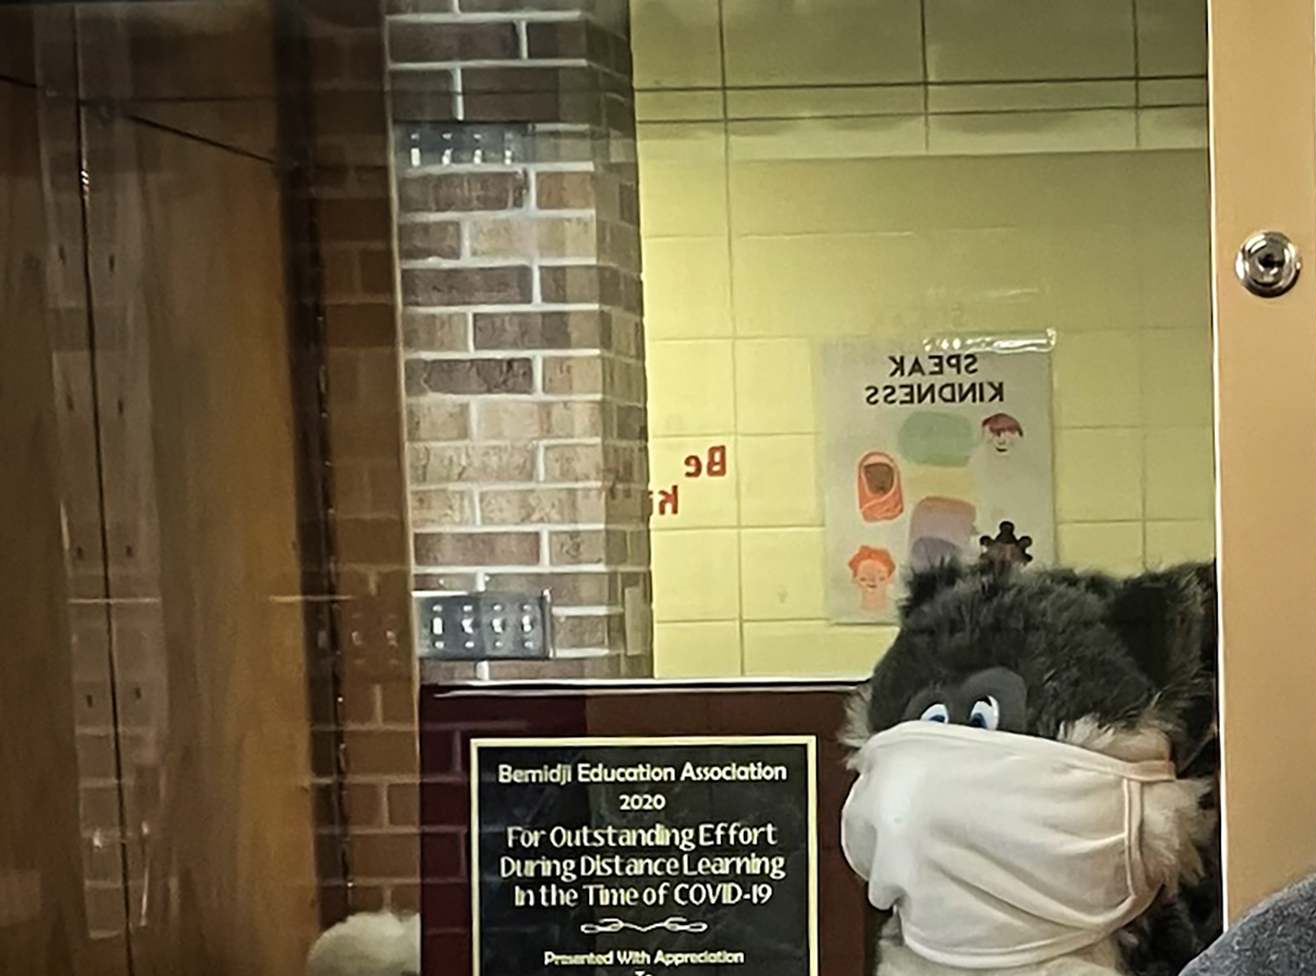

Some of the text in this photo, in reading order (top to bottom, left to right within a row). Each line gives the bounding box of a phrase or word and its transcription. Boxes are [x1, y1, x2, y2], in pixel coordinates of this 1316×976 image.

[498, 762, 788, 785] Bemidji Education Association
[619, 794, 666, 810] 2020
[507, 823, 778, 851] For Outstanding Effort
[500, 852, 786, 882] During Distance Learning
[514, 883, 773, 907] In the Time of COVID-19
[544, 950, 744, 966] Presented With Appreciation
